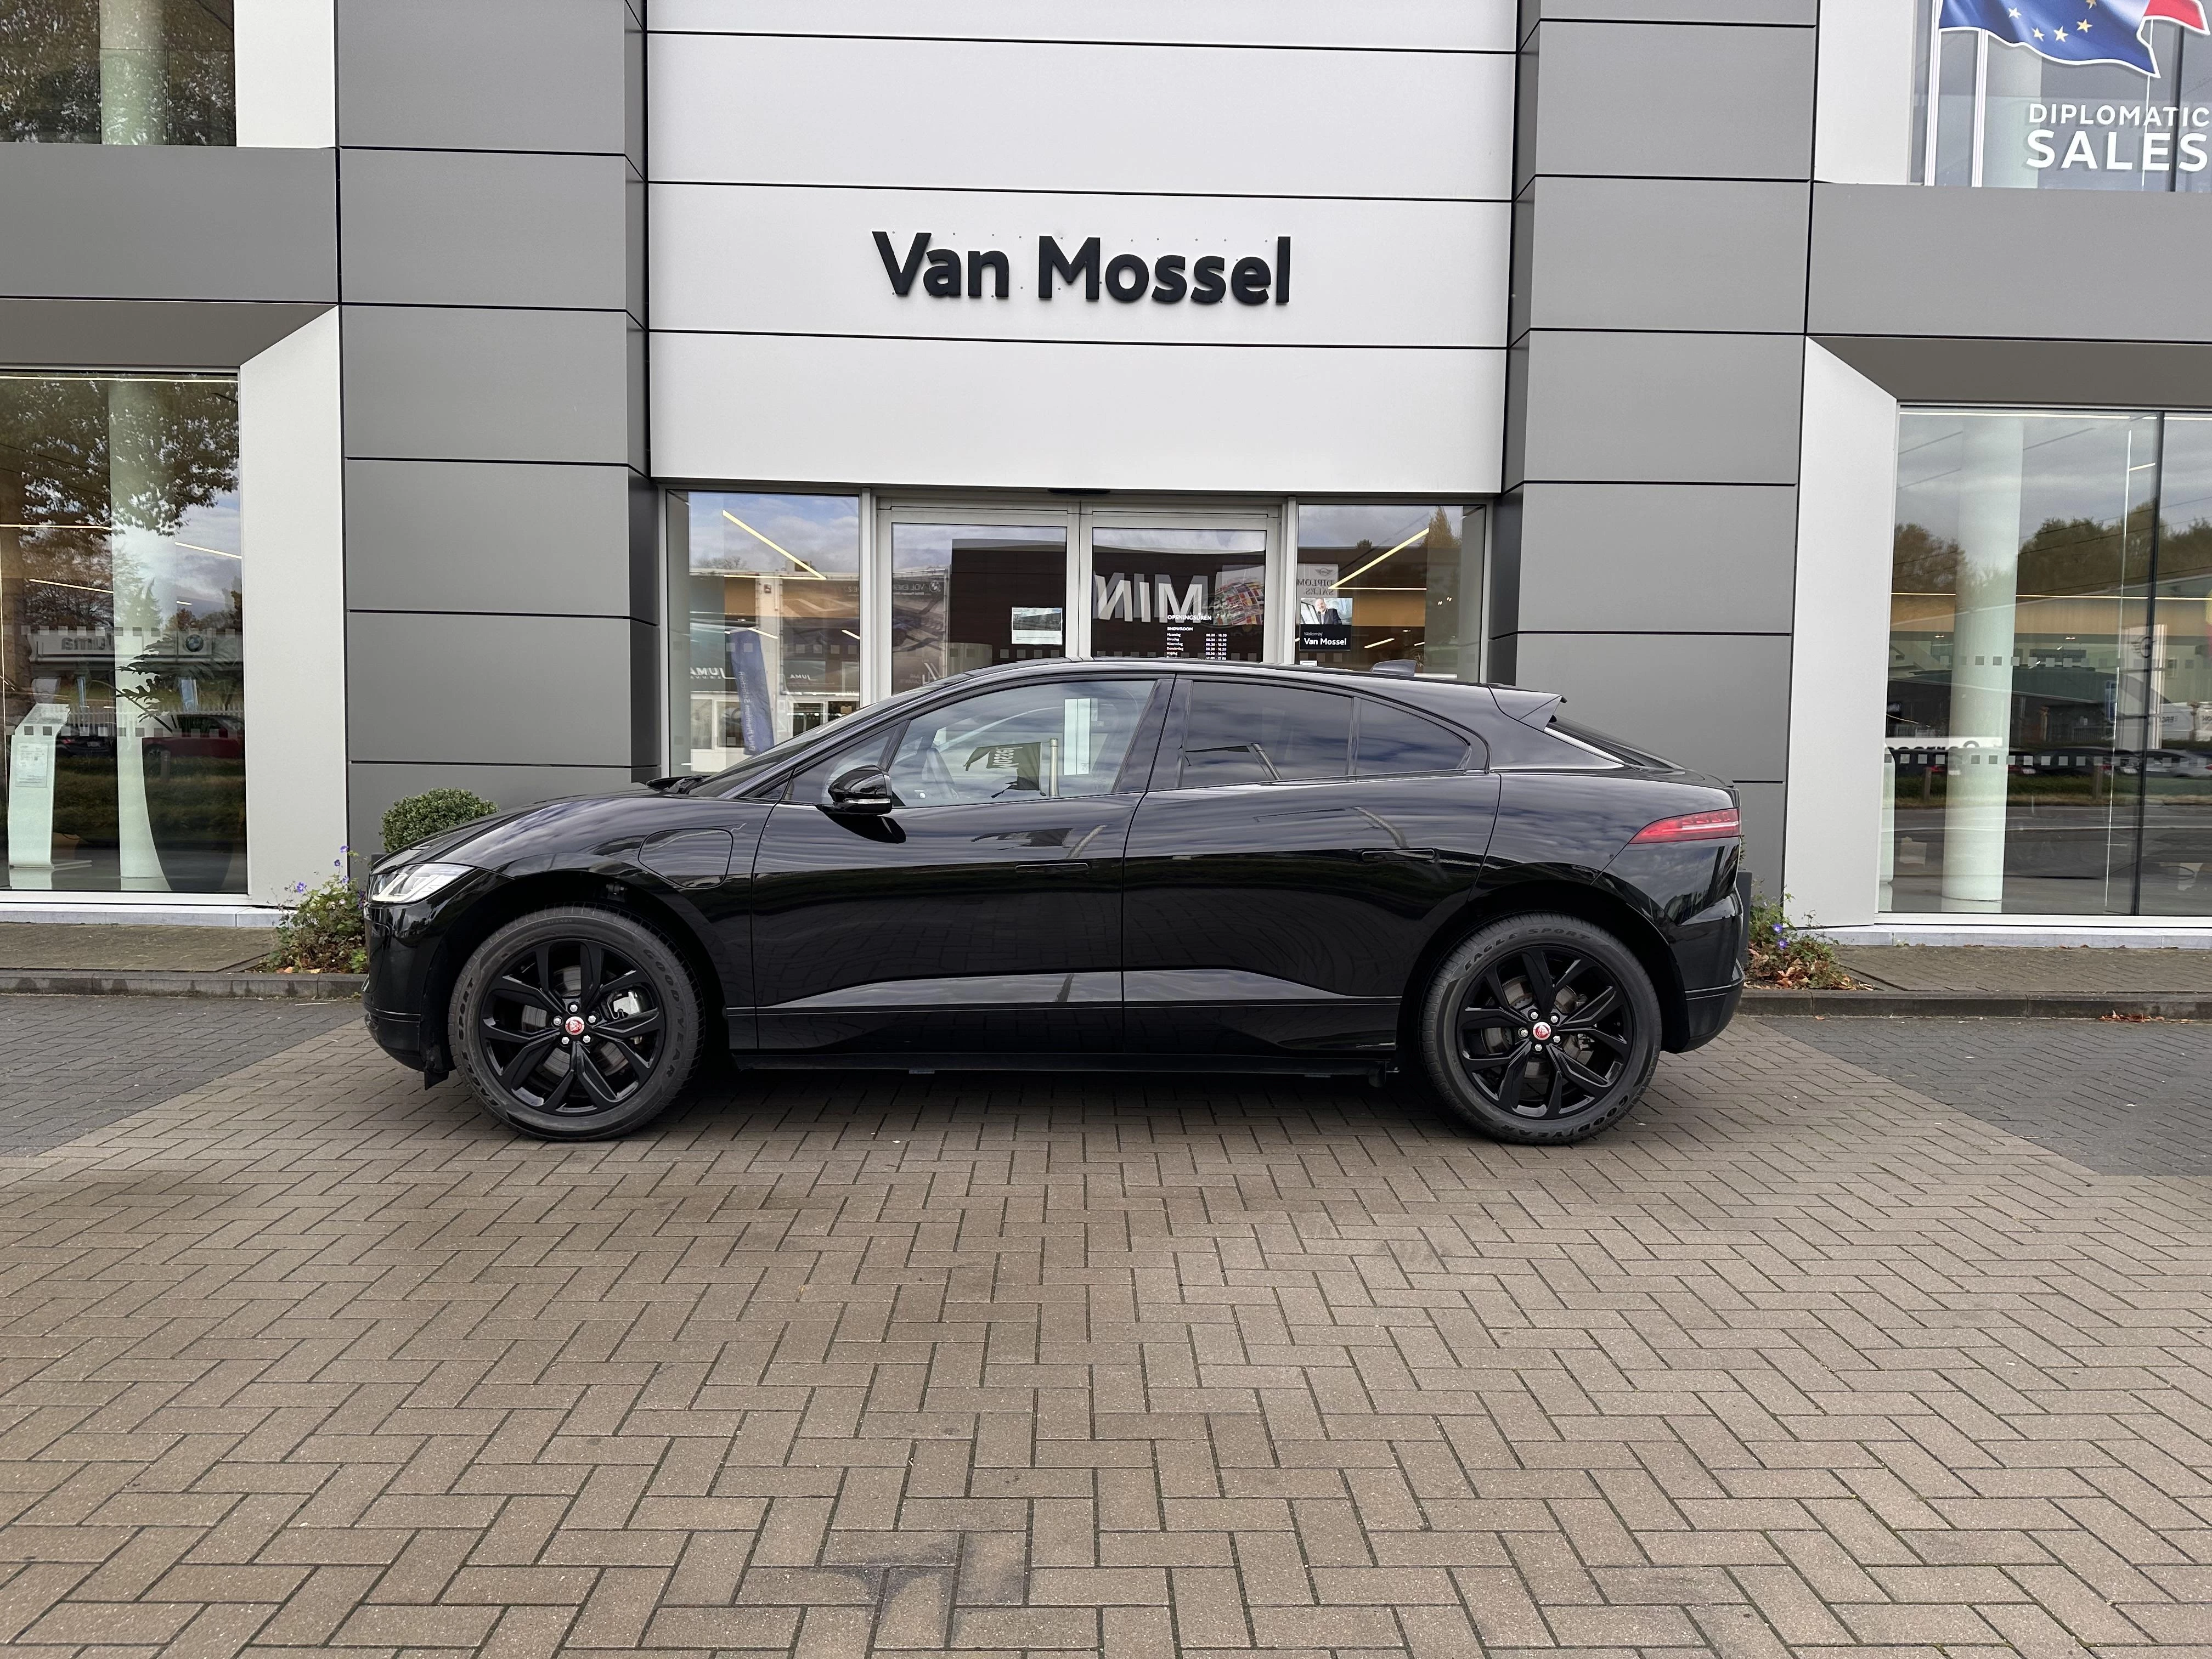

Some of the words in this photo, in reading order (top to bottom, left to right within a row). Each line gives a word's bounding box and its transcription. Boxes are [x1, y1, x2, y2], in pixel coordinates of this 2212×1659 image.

[2029, 103, 2210, 127] DIPLOMATIC
[2027, 128, 2209, 172] SALES
[871, 230, 1010, 297] Van
[1037, 236, 1291, 304] Mossel
[1464, 932, 1518, 972] EAGLE
[1527, 928, 1591, 940] SPORT
[458, 977, 473, 1041] SPORT
